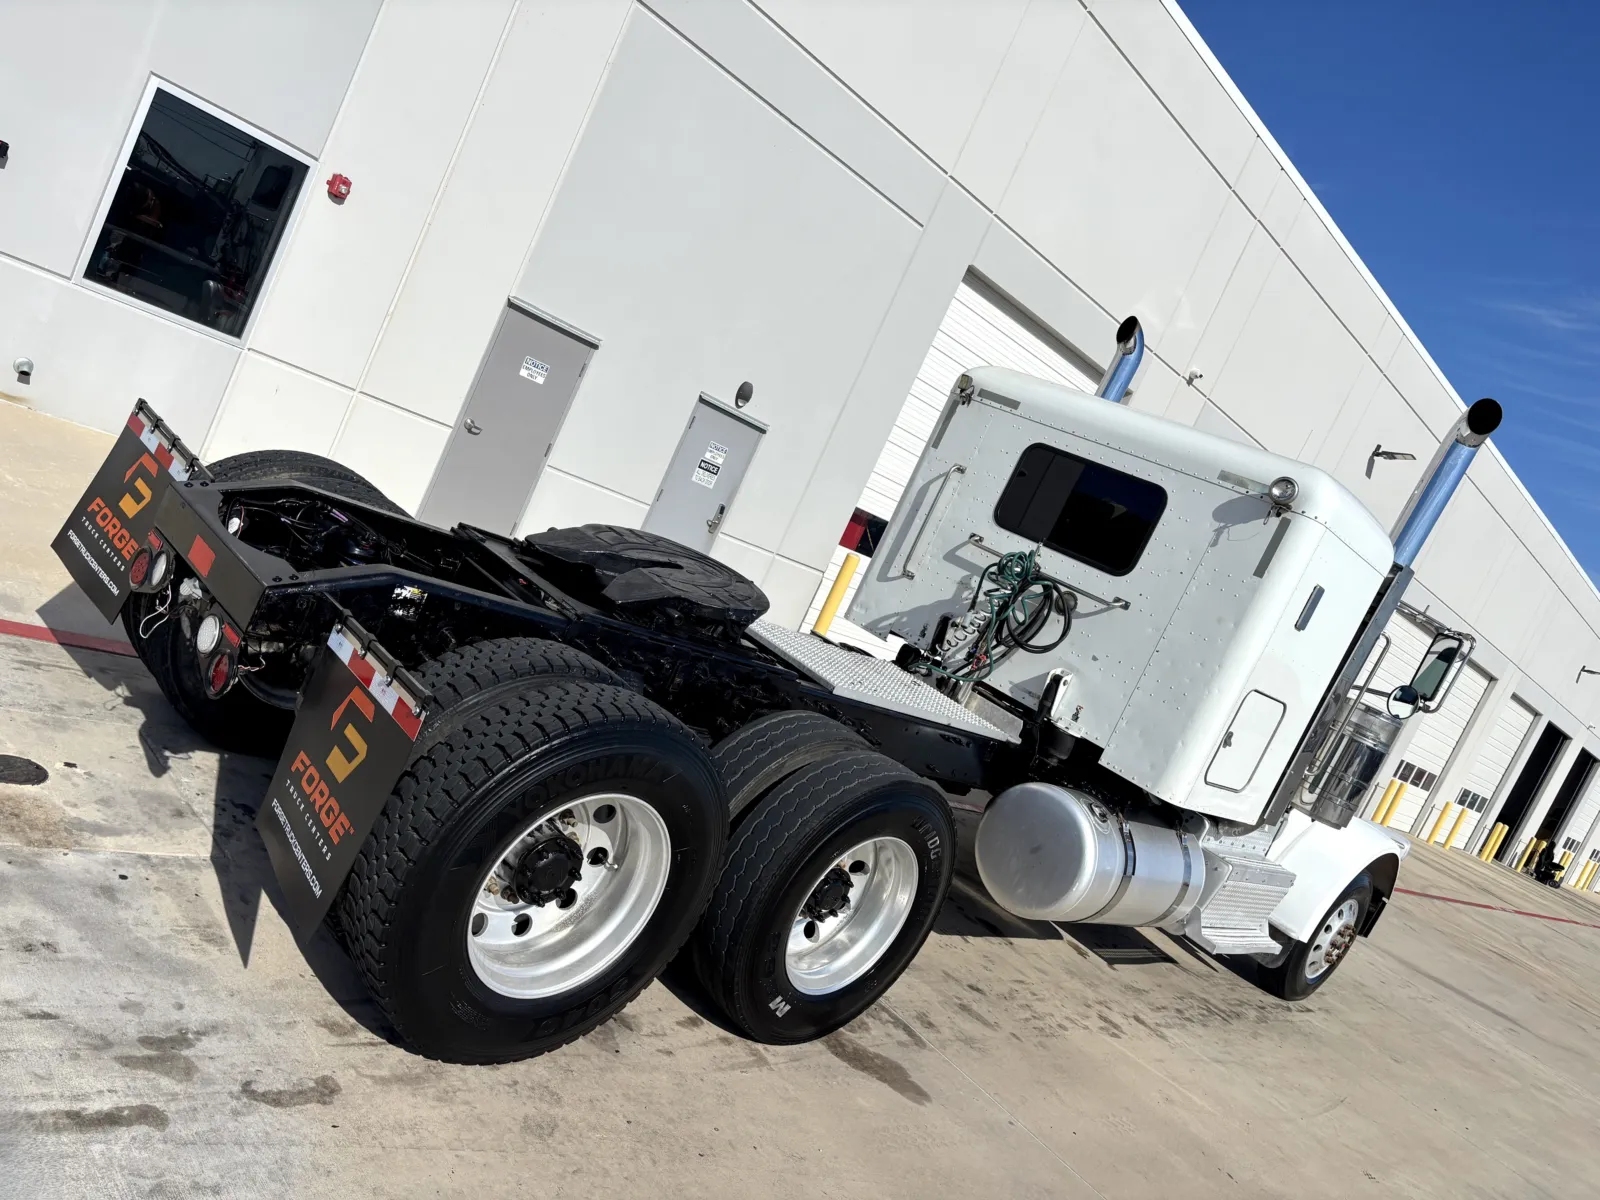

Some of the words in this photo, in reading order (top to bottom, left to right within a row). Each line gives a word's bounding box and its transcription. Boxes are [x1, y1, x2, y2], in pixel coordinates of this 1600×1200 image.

[522, 364, 546, 379] EMPLOYEES
[525, 357, 549, 373] NOTICE
[526, 372, 538, 380] ONLY
[700, 461, 719, 473] NOTICE
[81, 516, 100, 539] TRUCK
[99, 539, 126, 572] CENTERS
[87, 496, 140, 561] FORGE
[67, 529, 120, 597] FORGETRUCKCENTERS.COM
[284, 778, 305, 812] TRUCK
[304, 812, 332, 862] CENTERS
[290, 750, 351, 845] FORGE
[271, 797, 323, 899] FORGETRUCKCENTERS.COM
